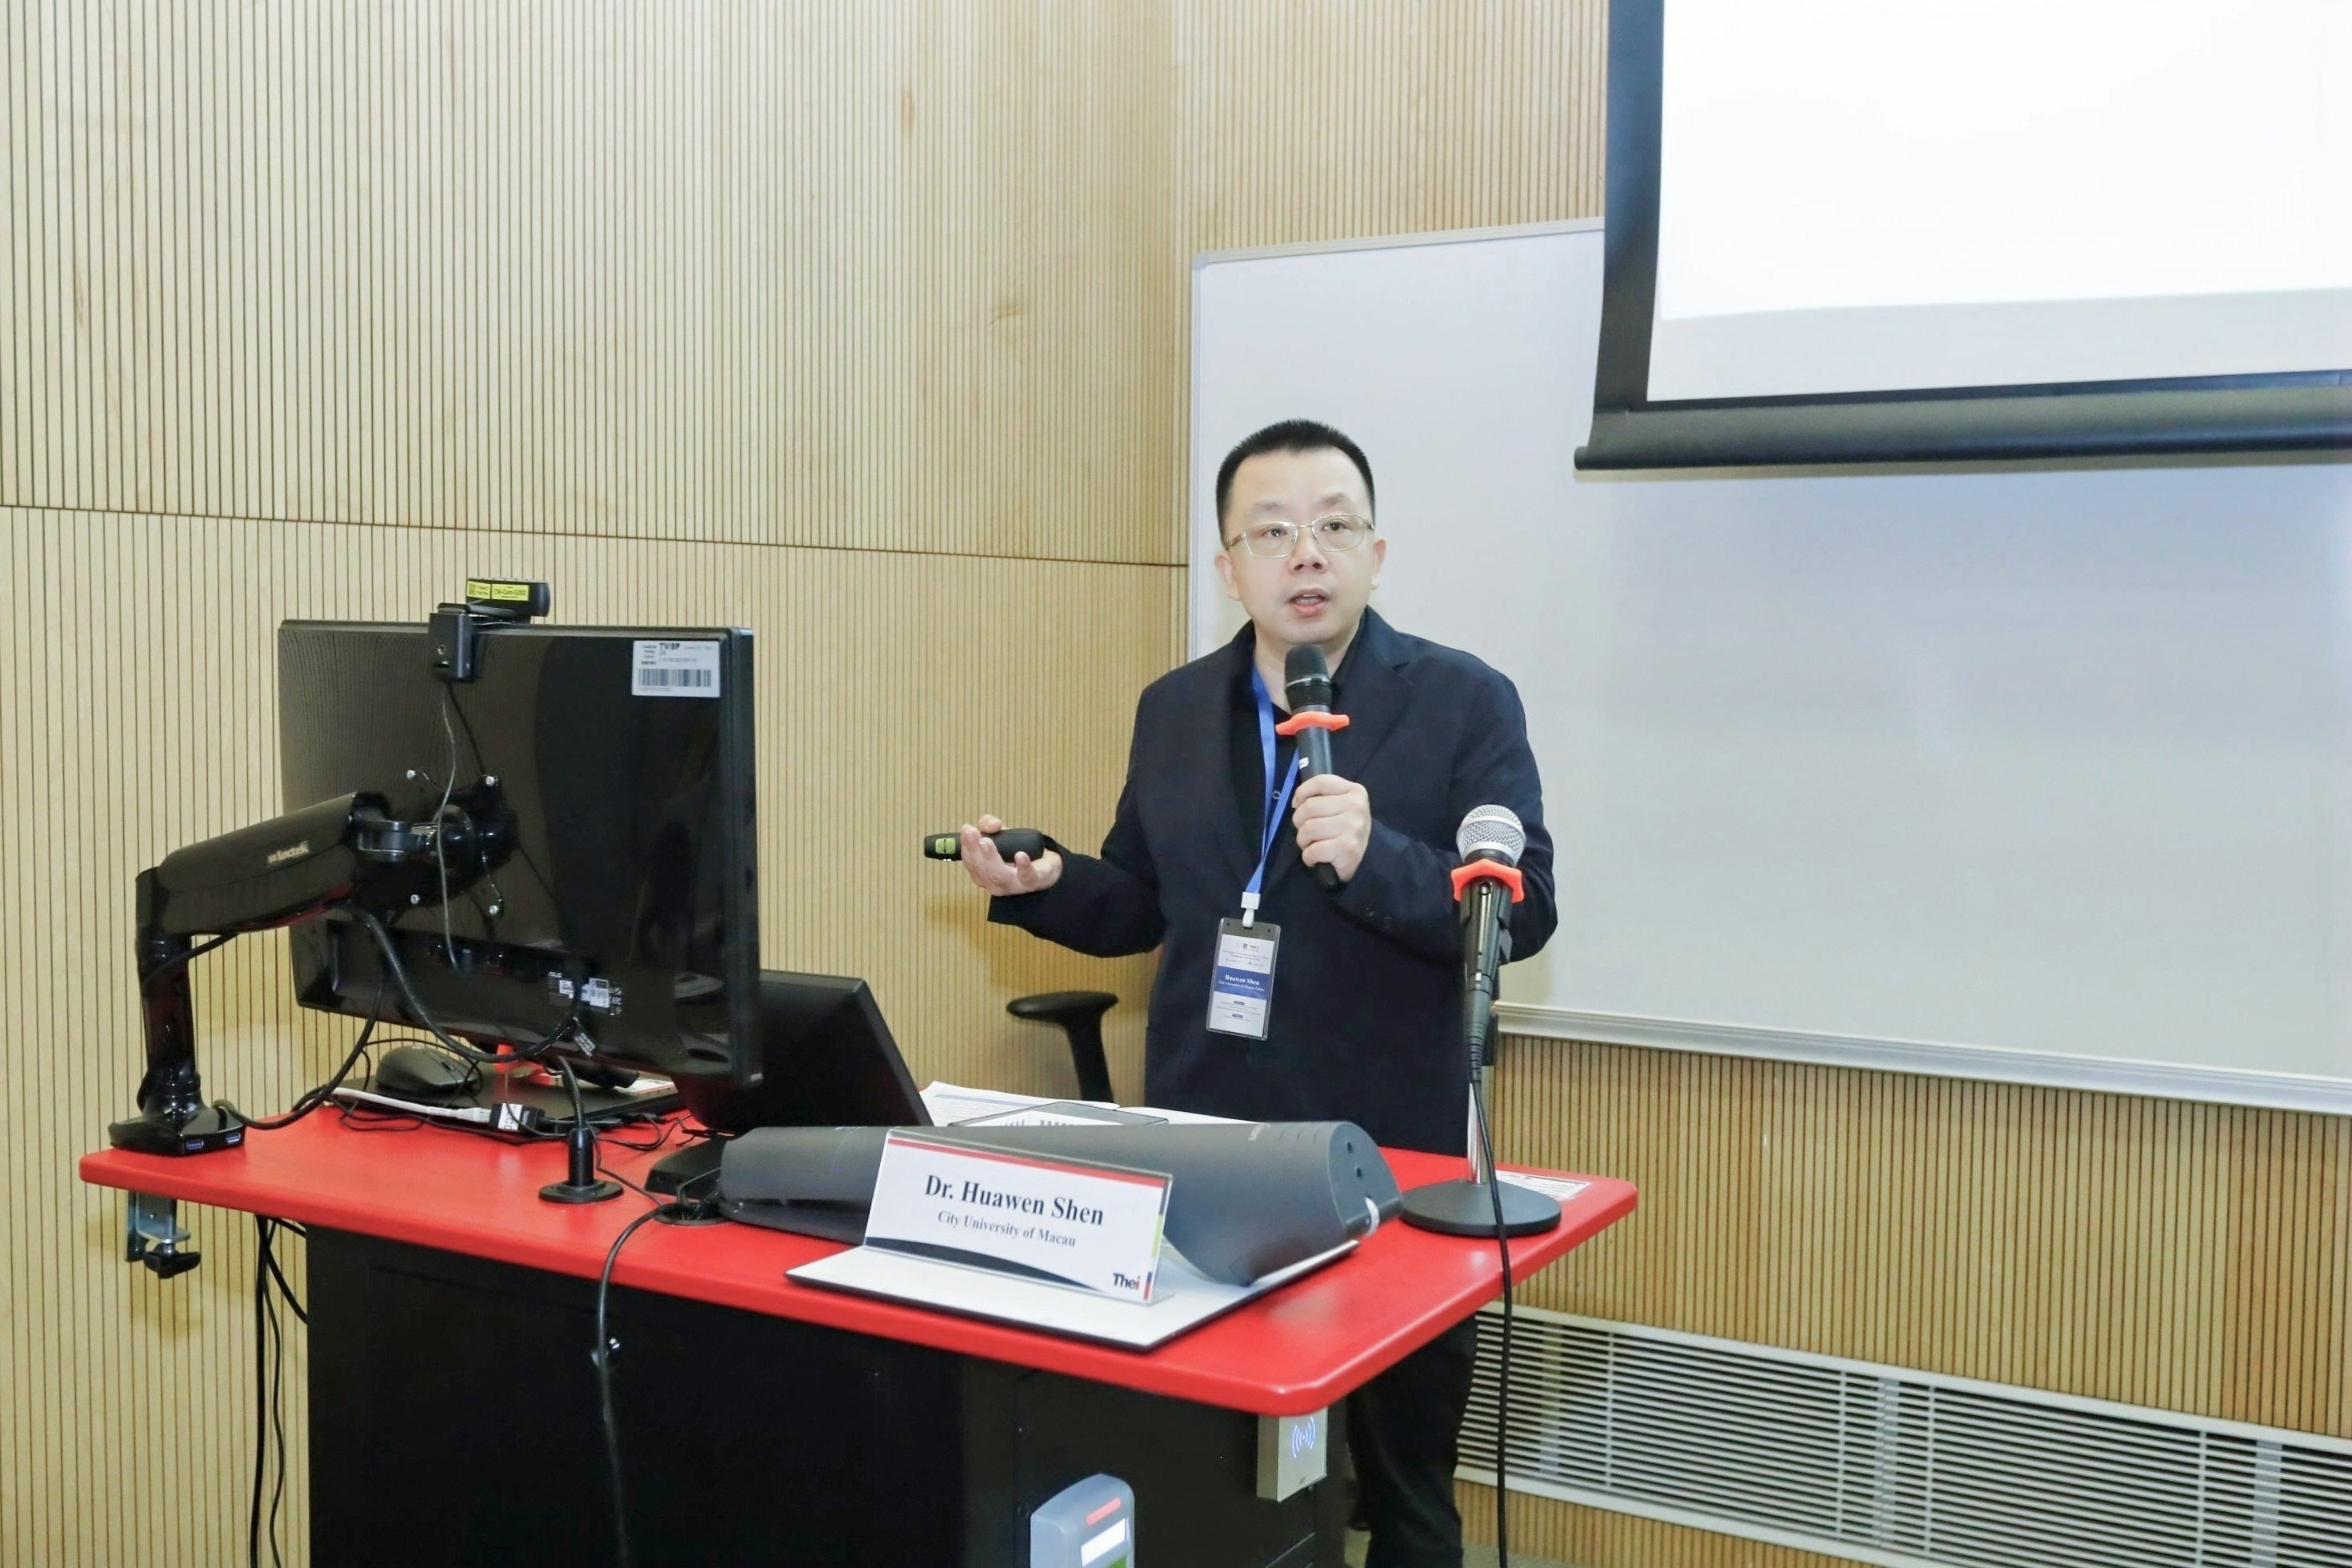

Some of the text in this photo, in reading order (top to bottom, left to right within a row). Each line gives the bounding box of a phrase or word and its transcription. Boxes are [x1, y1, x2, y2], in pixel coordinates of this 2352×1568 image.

[1225, 974, 1246, 983] Huawen
[924, 1174, 1104, 1226] Dr. Huawen Shen
[938, 1210, 1077, 1247] City University of Macau
[1113, 1273, 1141, 1290] Thei
